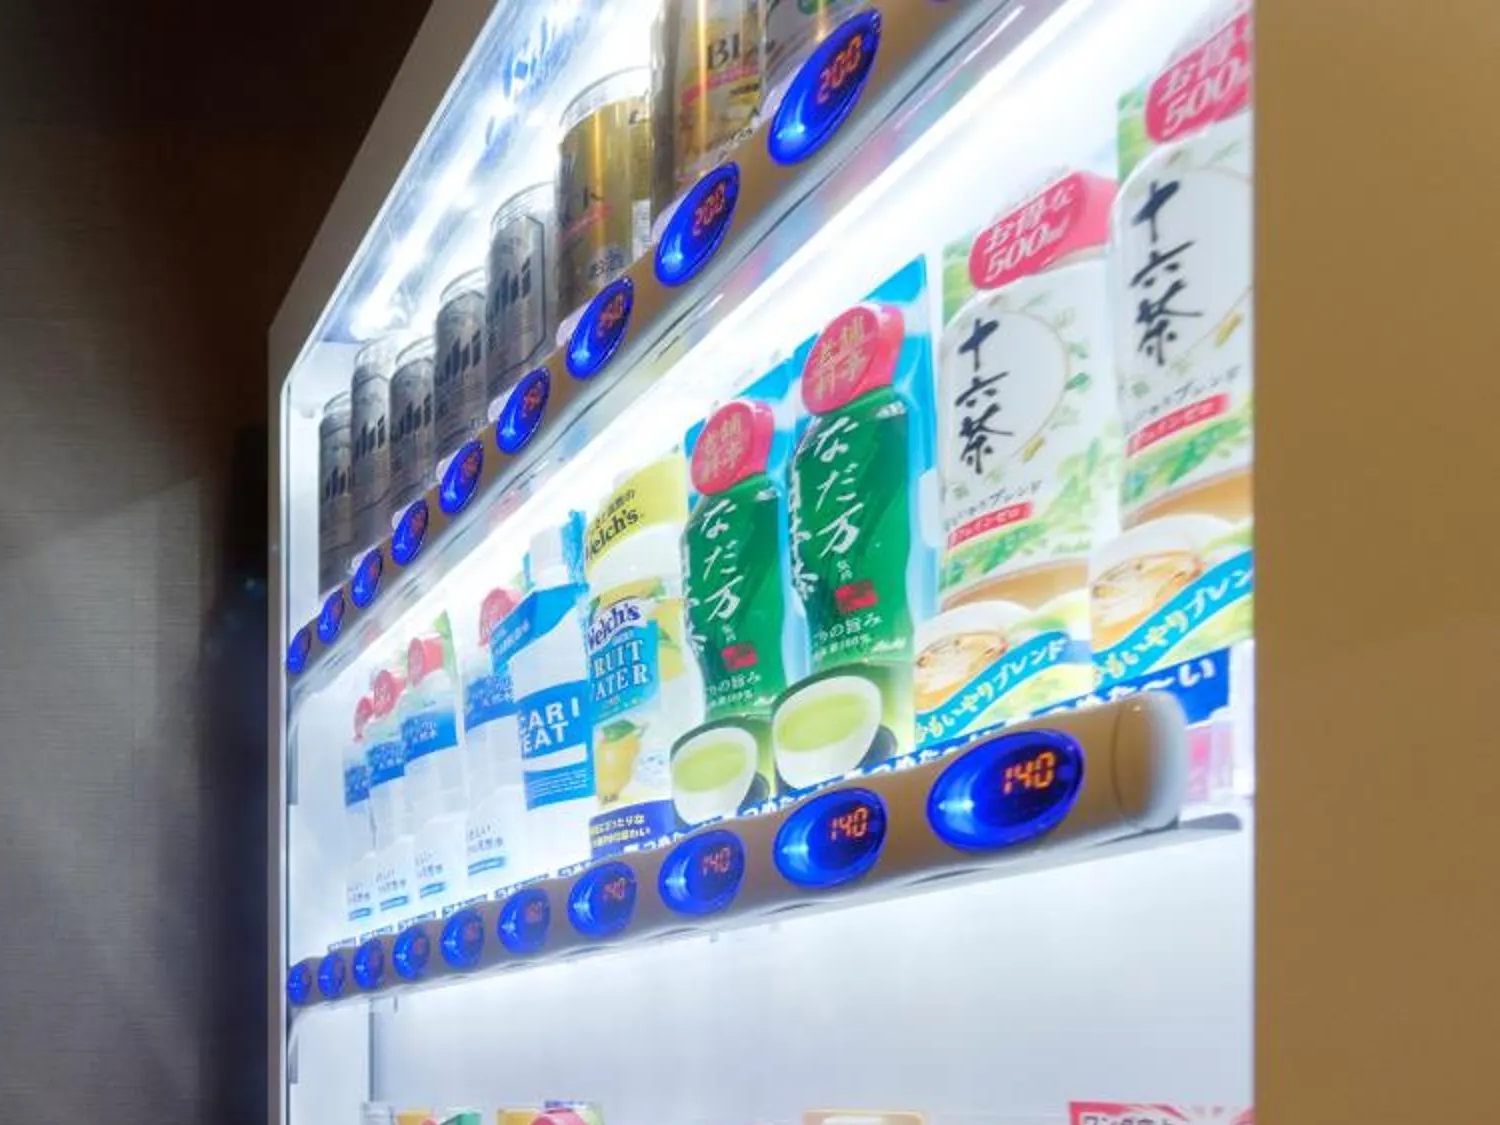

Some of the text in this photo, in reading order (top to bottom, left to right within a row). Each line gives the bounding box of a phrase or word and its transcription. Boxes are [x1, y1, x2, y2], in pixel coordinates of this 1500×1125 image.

[1131, 180, 1204, 366] 十六茶
[958, 318, 1012, 474] 十六茶
[1003, 750, 1057, 795] 140
[831, 806, 870, 842] 140
